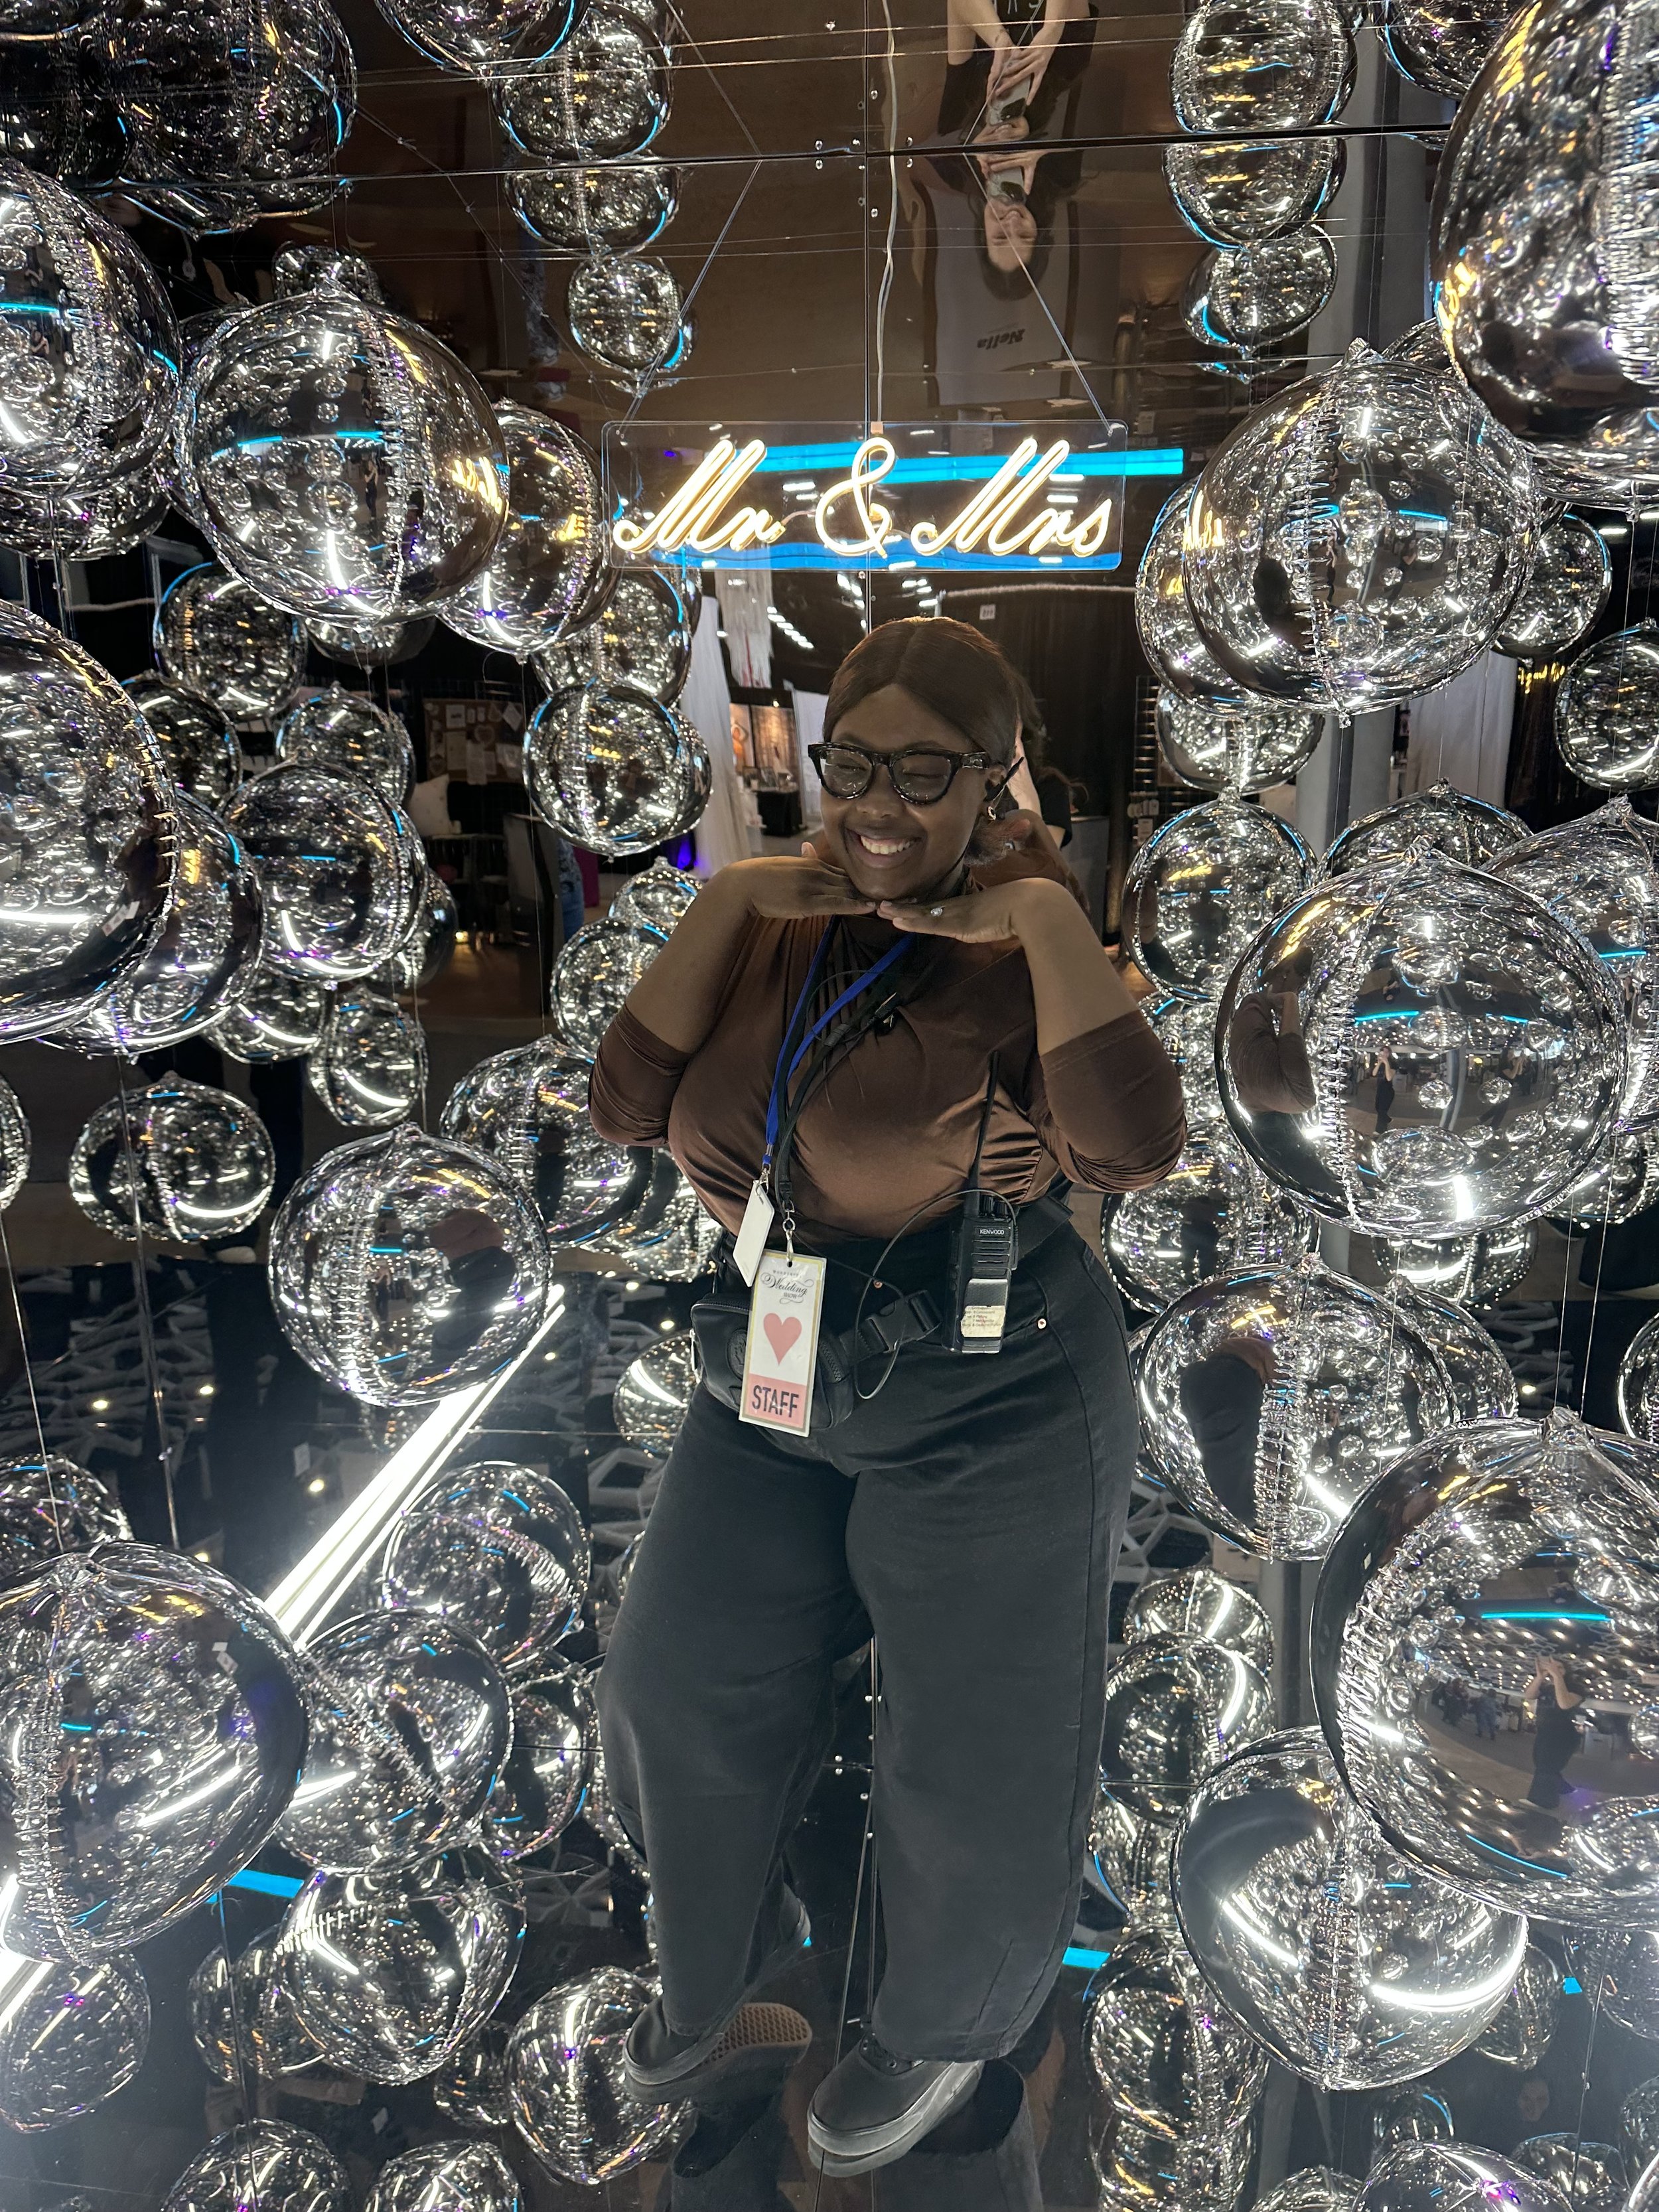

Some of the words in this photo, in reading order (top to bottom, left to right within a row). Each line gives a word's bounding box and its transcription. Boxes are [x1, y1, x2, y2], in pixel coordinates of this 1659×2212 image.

[613, 439, 784, 553] Mr
[816, 437, 895, 559] &
[910, 437, 1112, 557] Mrs
[760, 1272, 814, 1297] Wedding
[752, 1384, 799, 1418] STAFF
